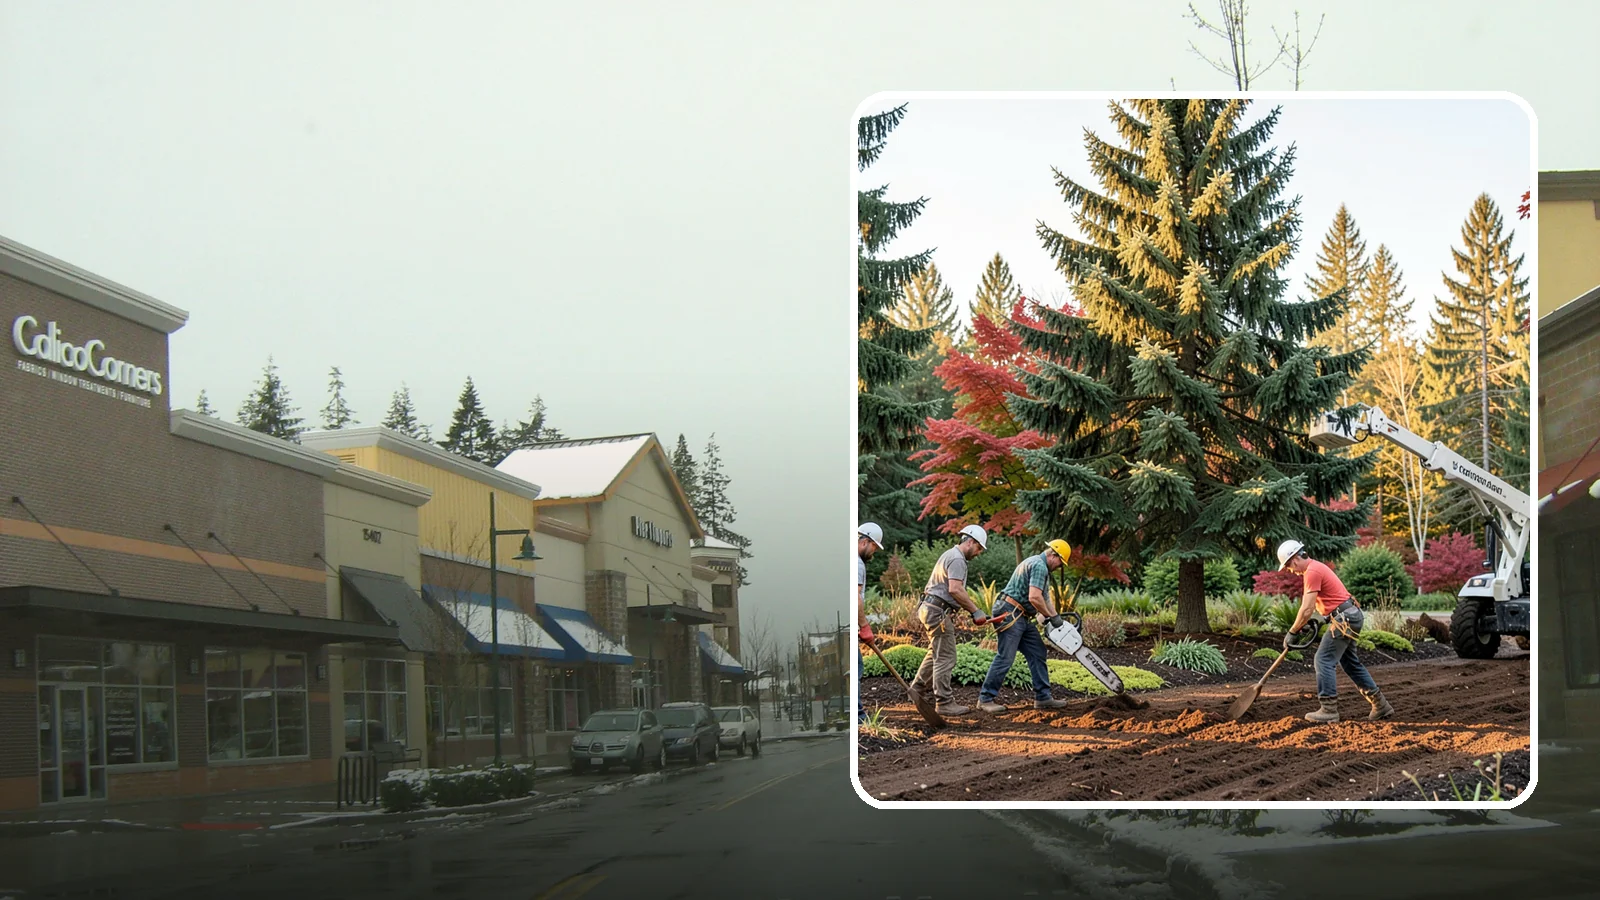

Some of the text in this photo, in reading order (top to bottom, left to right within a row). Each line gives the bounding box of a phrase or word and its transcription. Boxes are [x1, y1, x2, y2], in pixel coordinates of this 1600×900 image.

[17, 360, 151, 408] FABRICS WINDOW TREATMENTS FURNITURE
